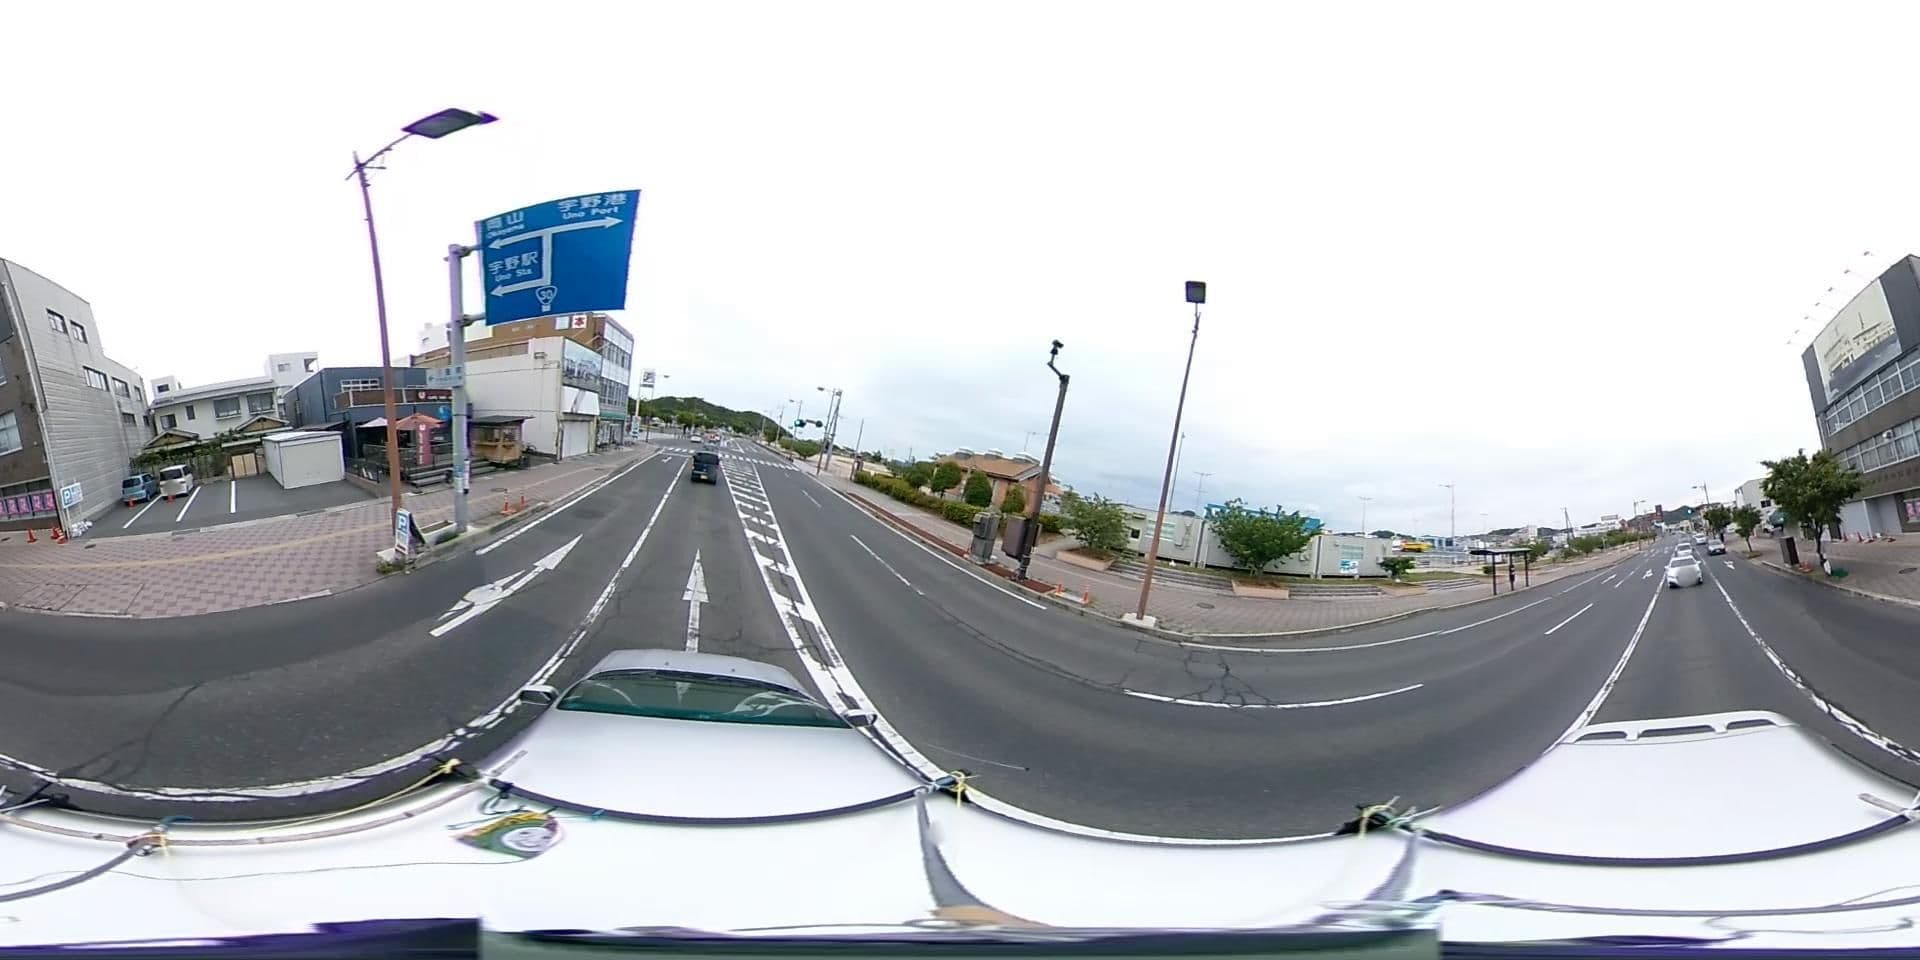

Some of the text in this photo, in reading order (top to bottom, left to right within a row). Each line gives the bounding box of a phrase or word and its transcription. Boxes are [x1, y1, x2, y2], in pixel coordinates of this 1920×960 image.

[558, 193, 627, 213] 宇野港
[562, 206, 618, 220] Uno Port
[487, 212, 524, 231] 岡山
[488, 251, 539, 275] 宇野駅
[540, 290, 554, 299] 30
[64, 490, 71, 504] P
